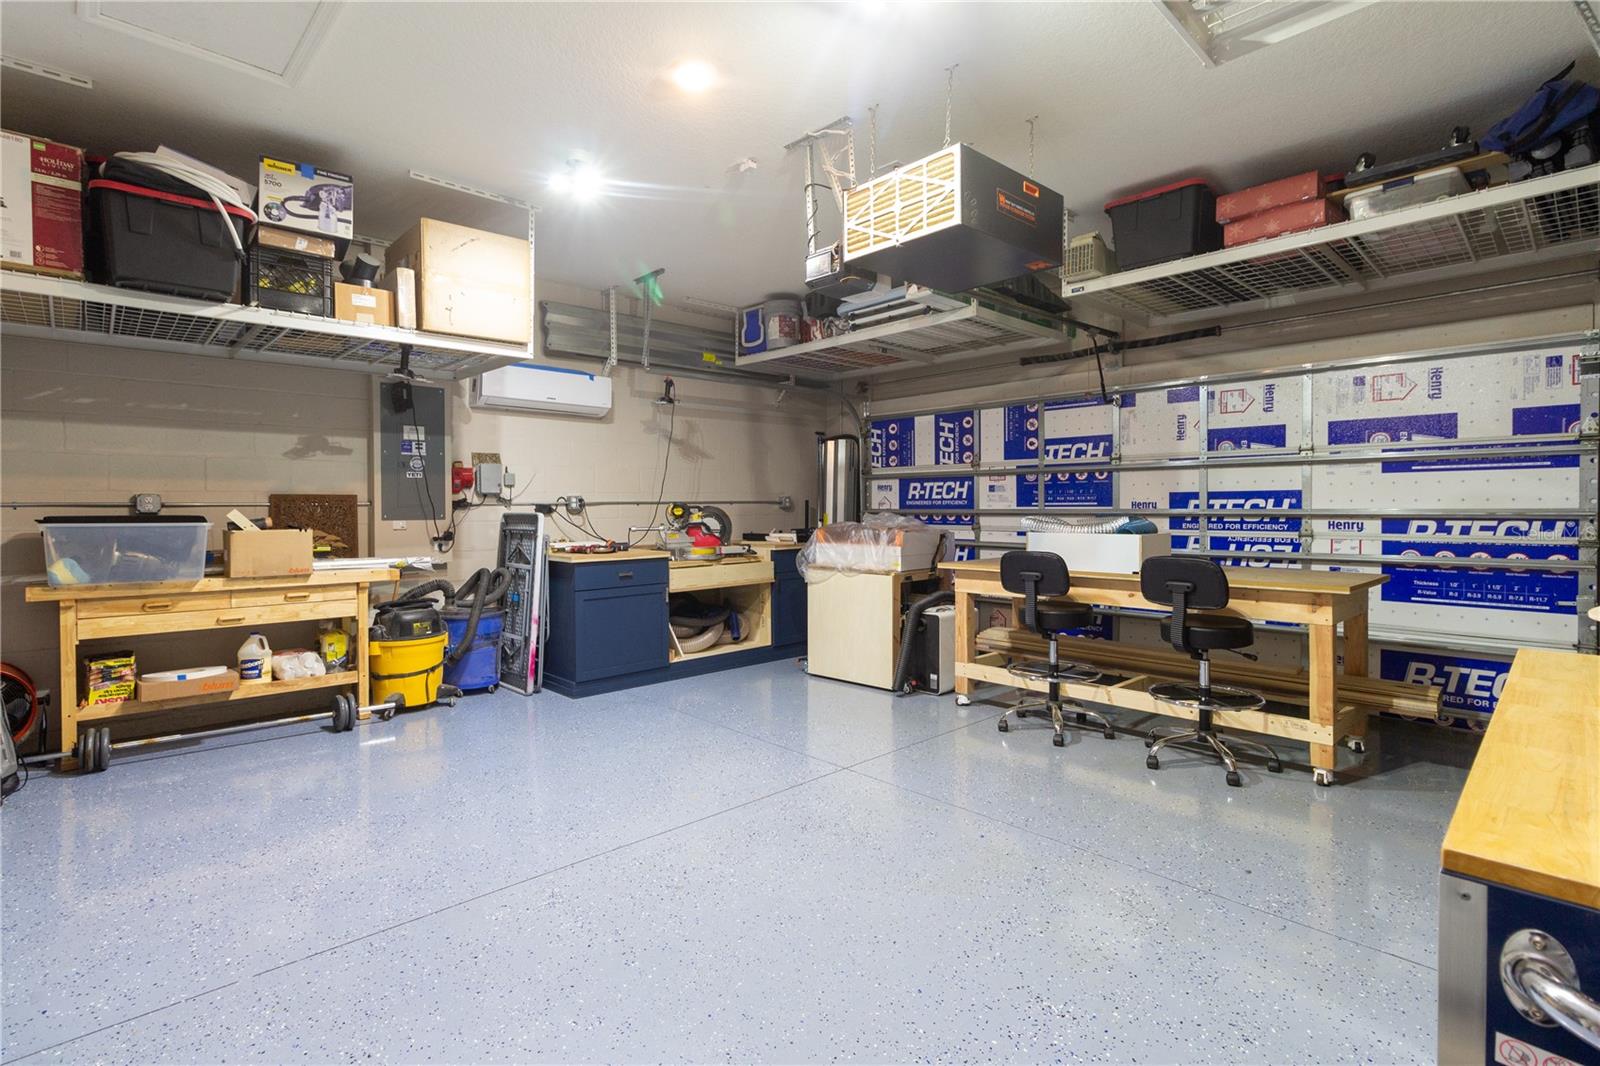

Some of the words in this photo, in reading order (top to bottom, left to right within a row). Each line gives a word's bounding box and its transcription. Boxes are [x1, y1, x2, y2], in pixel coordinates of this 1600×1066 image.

[264, 179, 282, 187] 5700
[1428, 367, 1443, 400] Henry
[1263, 383, 1276, 413] Henry
[1176, 414, 1187, 441] Henry
[940, 421, 955, 465] ECH
[1044, 442, 1105, 460] TECH
[907, 481, 969, 500] R-TECH
[1131, 501, 1157, 510] Henry
[1242, 523, 1289, 531] EFFICIENCY
[1328, 520, 1364, 532] Henry
[1467, 697, 1490, 708] FOR
